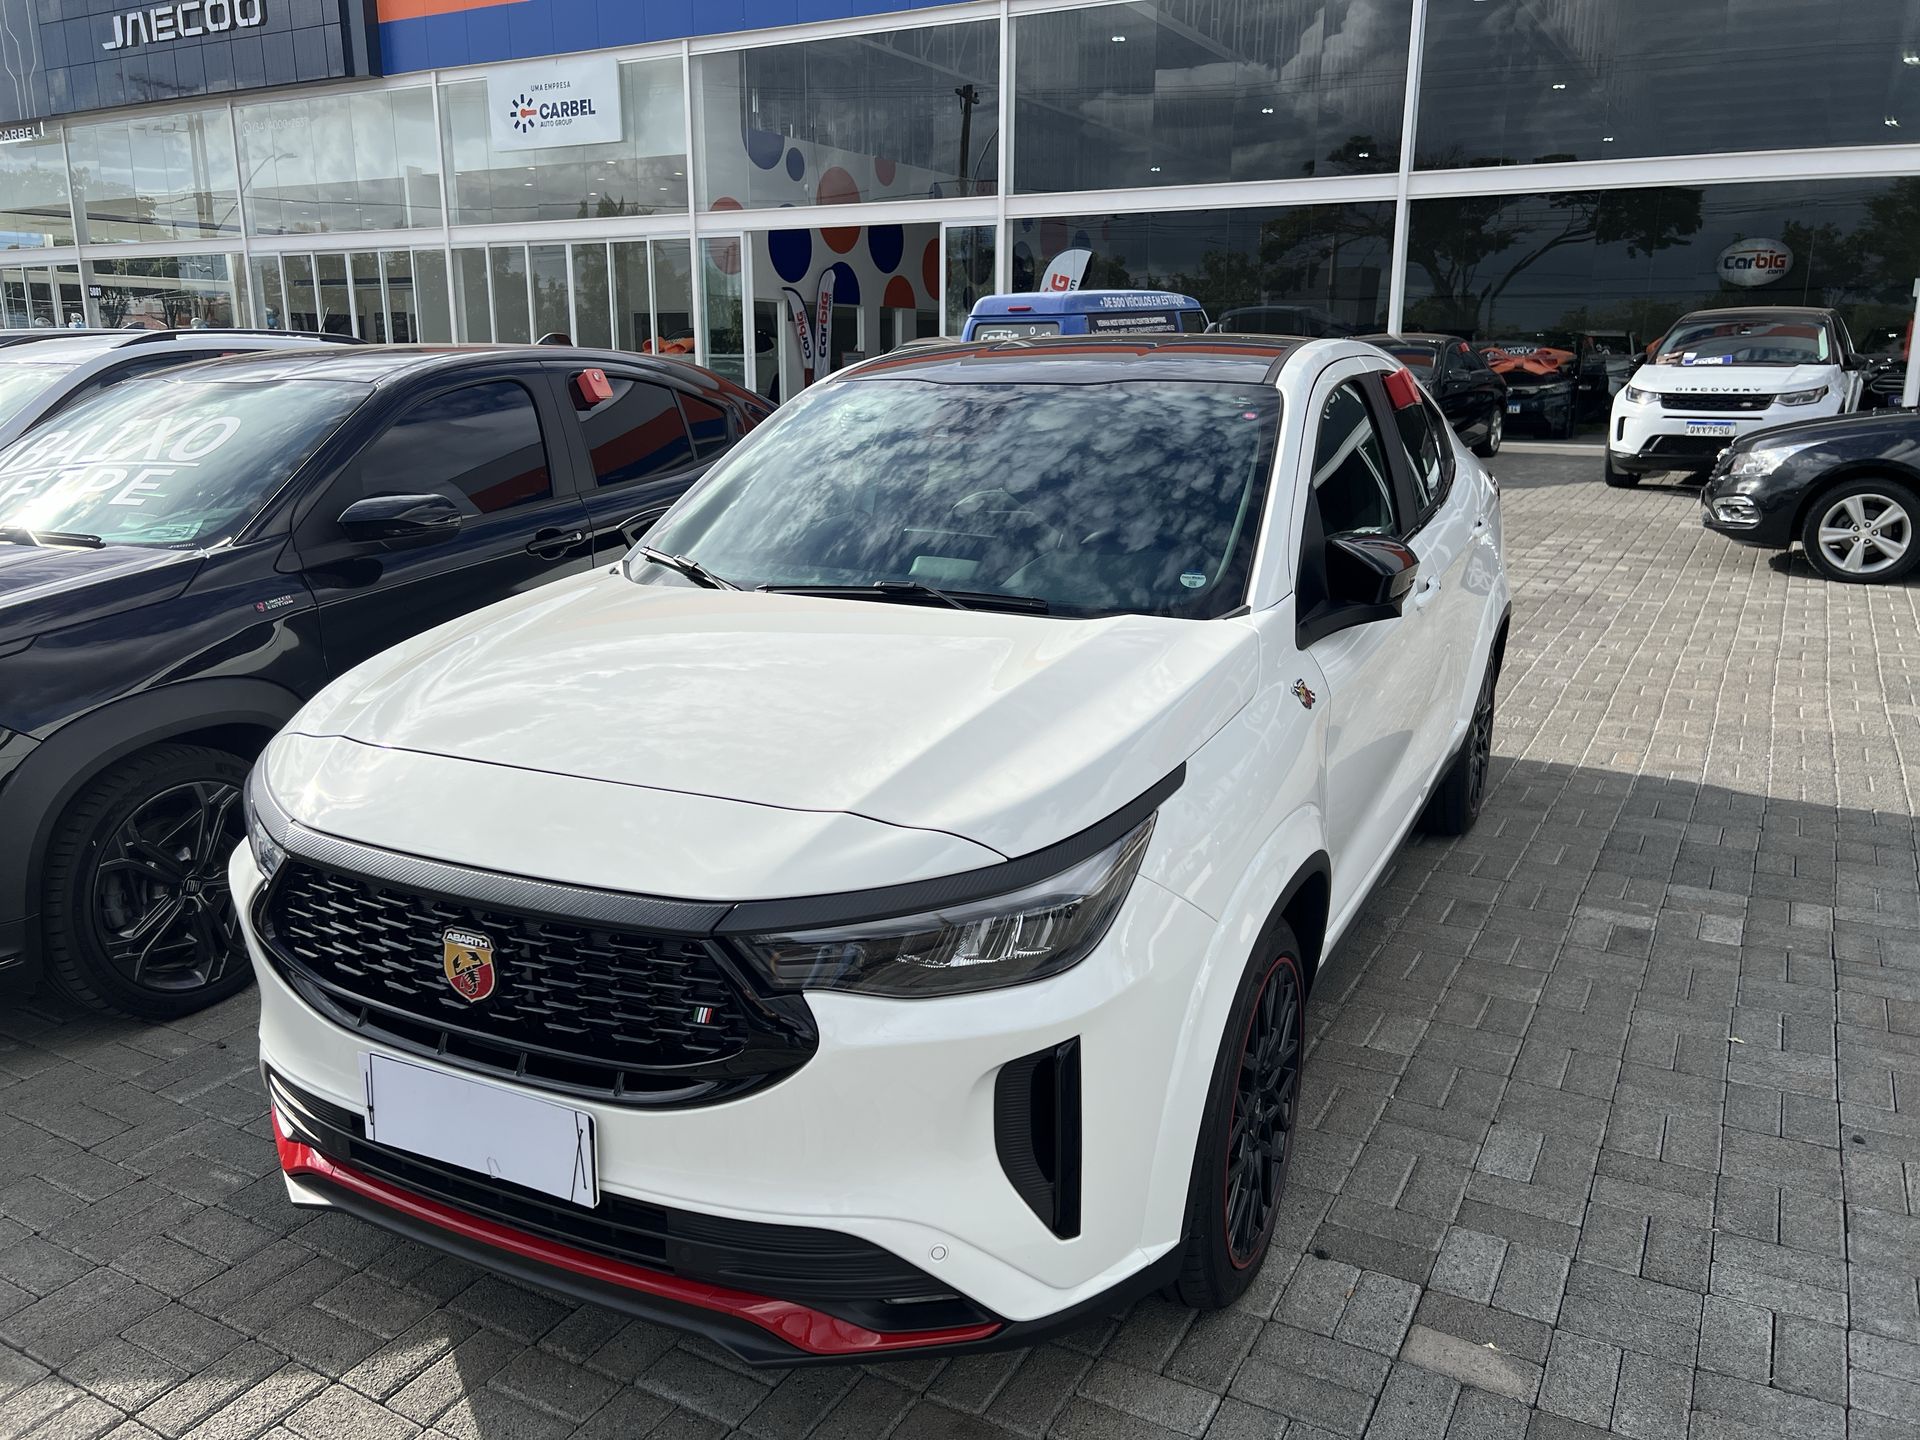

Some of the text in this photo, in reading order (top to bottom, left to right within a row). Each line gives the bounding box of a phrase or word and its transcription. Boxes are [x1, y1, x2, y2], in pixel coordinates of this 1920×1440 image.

[102, 0, 261, 50] JAECOO
[530, 81, 571, 92] UMA EMPRESA
[539, 99, 596, 119] CARBEL
[540, 119, 573, 128] AUTO GROUP
[1103, 297, 1113, 308] DE
[1112, 297, 1125, 307] 500
[1151, 296, 1161, 306] EM
[1160, 295, 1185, 307] ESTOQUE
[446, 932, 488, 948] ABARTH
